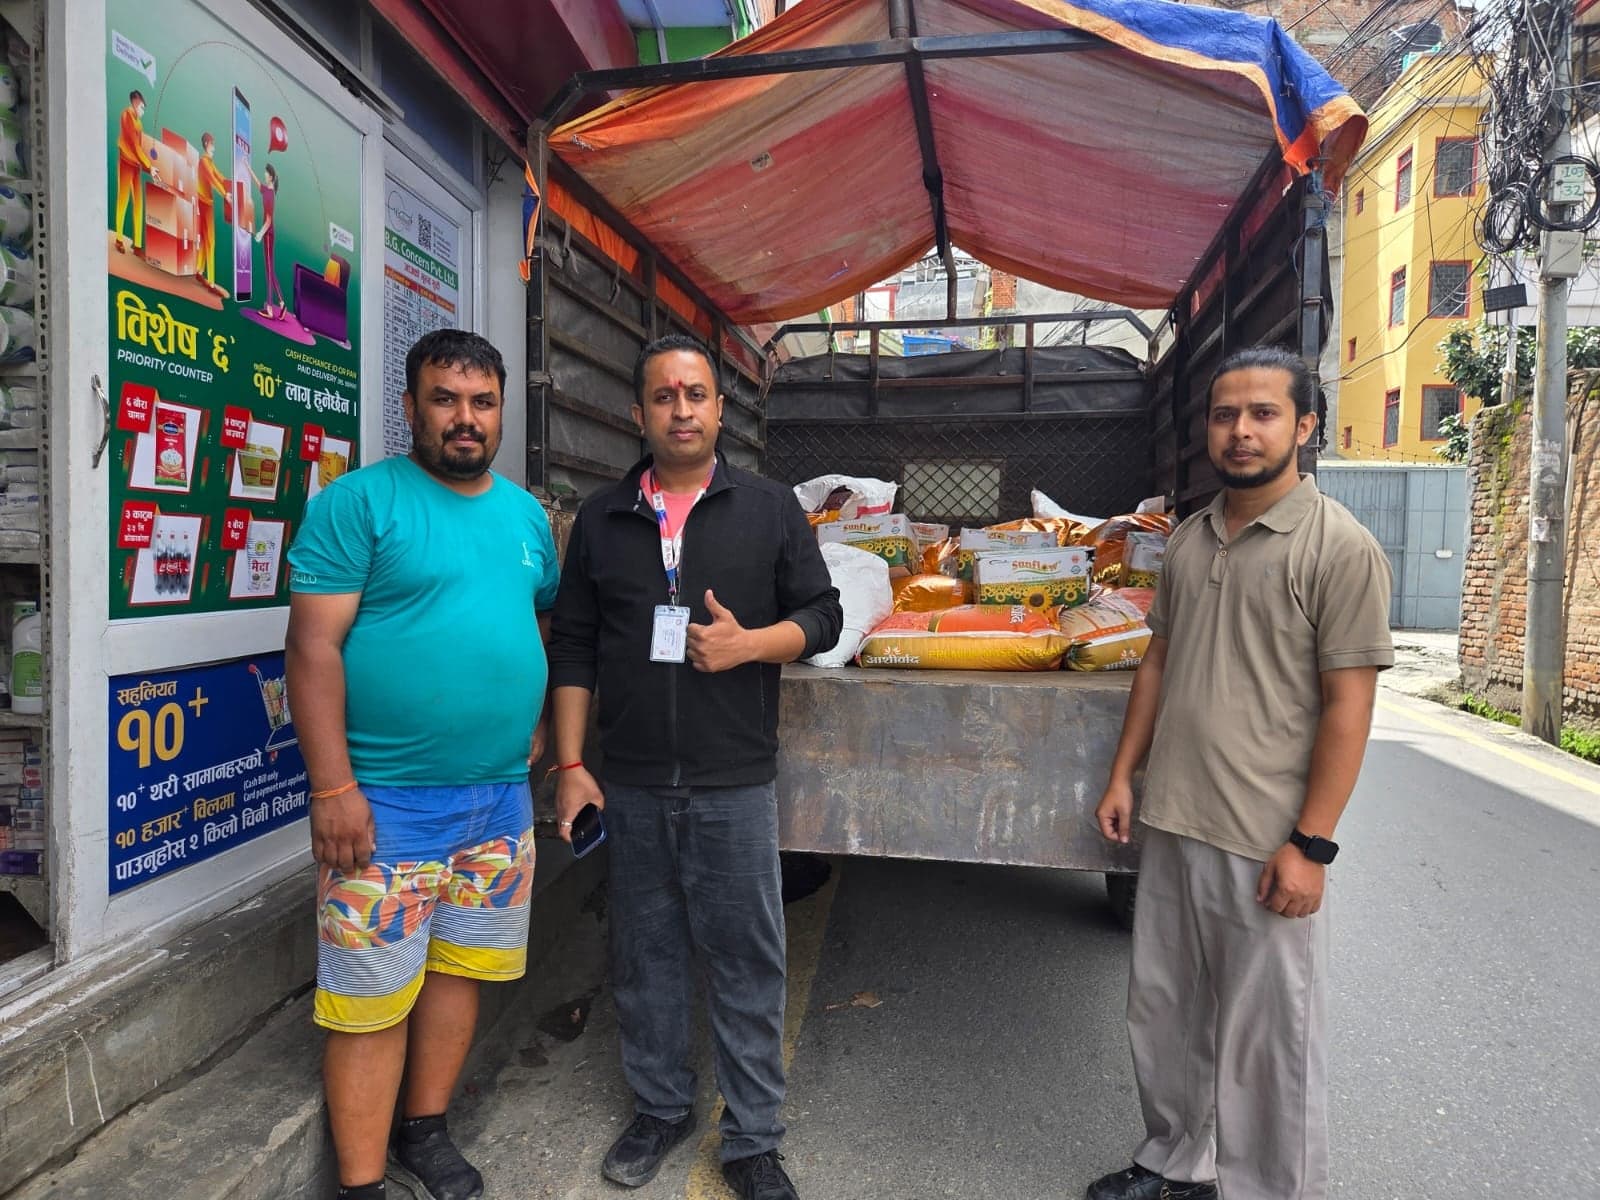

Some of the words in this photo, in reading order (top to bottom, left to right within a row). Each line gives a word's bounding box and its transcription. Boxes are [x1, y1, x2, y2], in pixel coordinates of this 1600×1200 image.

[401, 243, 429, 272] Concern
[430, 263, 443, 281] Pvt.
[444, 272, 456, 288] Ltd.
[117, 290, 198, 360] विशेष
[117, 348, 166, 373] PRIORITY
[168, 362, 214, 384] COUNTER
[285, 348, 302, 361] CASH
[297, 363, 311, 376] PAID
[312, 369, 337, 384] DELIVERY
[285, 381, 311, 409] लागु
[117, 680, 178, 706] सहुलियत
[149, 773, 180, 801] थरी
[256, 783, 278, 799] payment
[115, 828, 136, 849] १०
[193, 792, 236, 822] विलमा
[115, 838, 186, 881] पाउनुहोस्
[189, 834, 199, 850] २
[203, 814, 239, 846] किलो
[242, 801, 269, 830] चिनी
